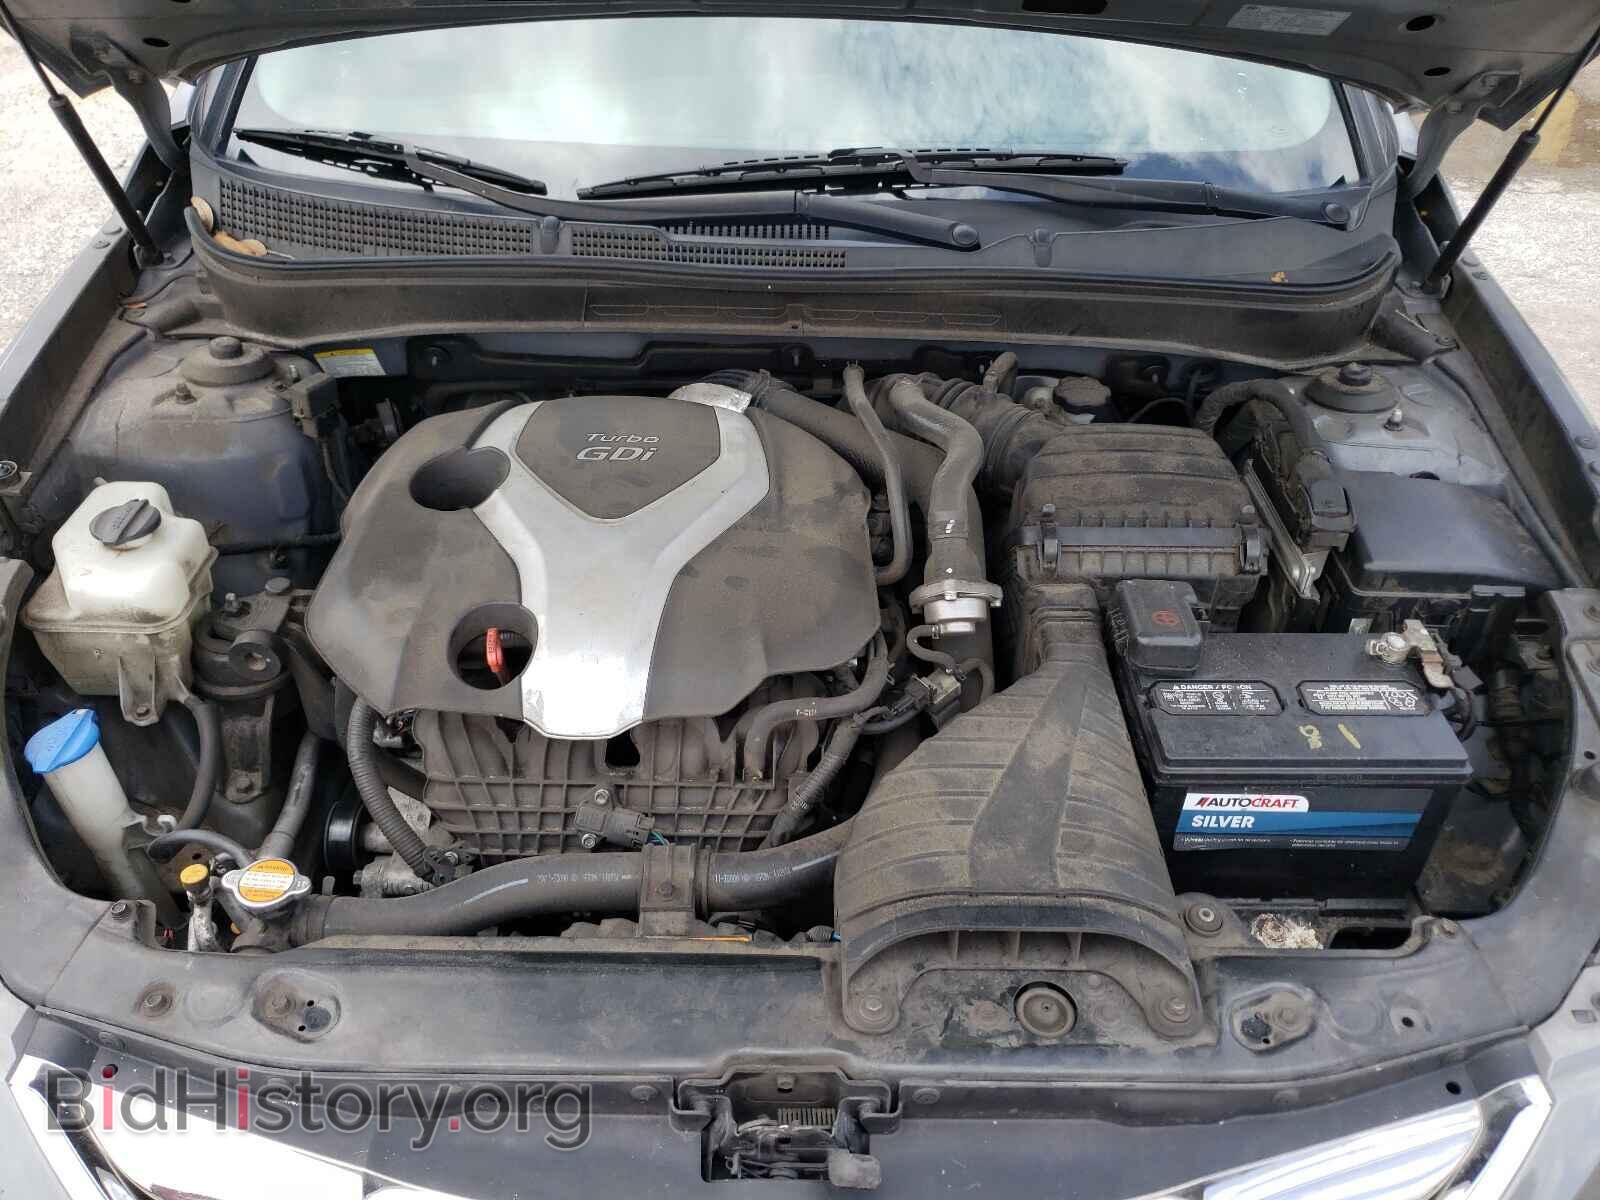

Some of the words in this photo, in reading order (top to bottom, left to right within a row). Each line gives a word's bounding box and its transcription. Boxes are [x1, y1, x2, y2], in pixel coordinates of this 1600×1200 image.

[586, 433, 660, 443] Turbo
[576, 446, 658, 461] GDi
[1206, 797, 1299, 809] AUTOCRAFT
[1191, 815, 1255, 829] SILVER
